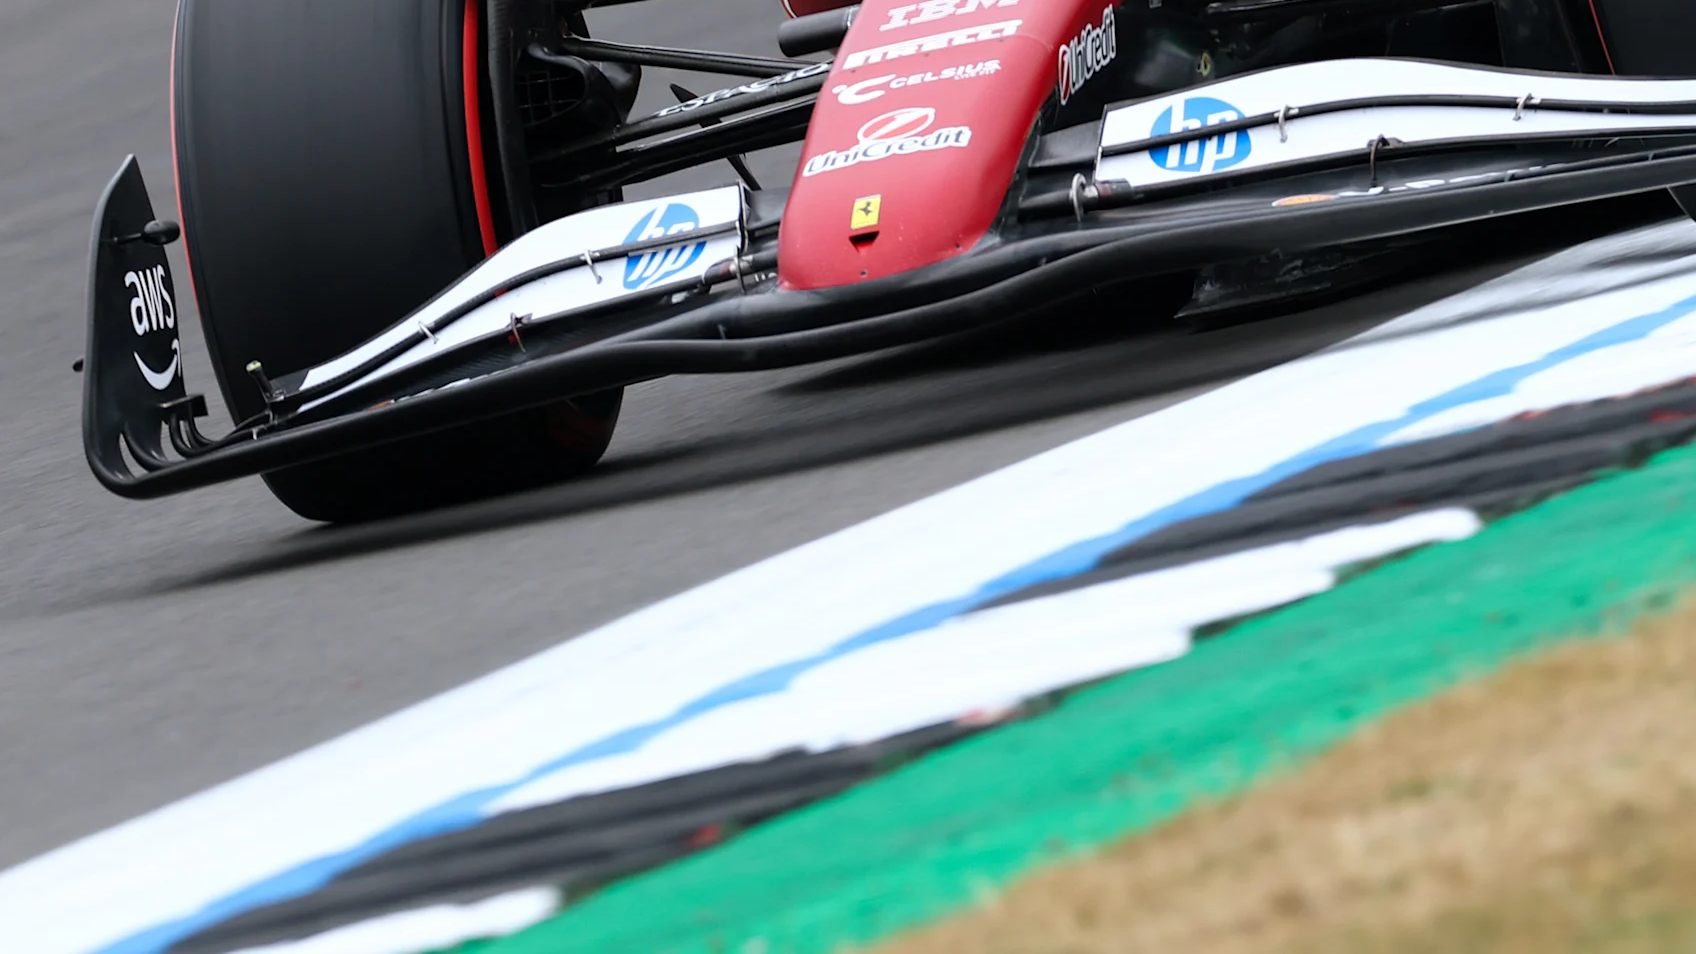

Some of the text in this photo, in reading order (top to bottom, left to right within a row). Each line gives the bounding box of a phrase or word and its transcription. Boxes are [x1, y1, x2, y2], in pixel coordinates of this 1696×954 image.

[889, 60, 1001, 89] CELSIUS
[803, 126, 972, 177] UniCredit
[1148, 96, 1252, 173] hp
[621, 202, 707, 290] hp
[124, 264, 175, 336] aws
